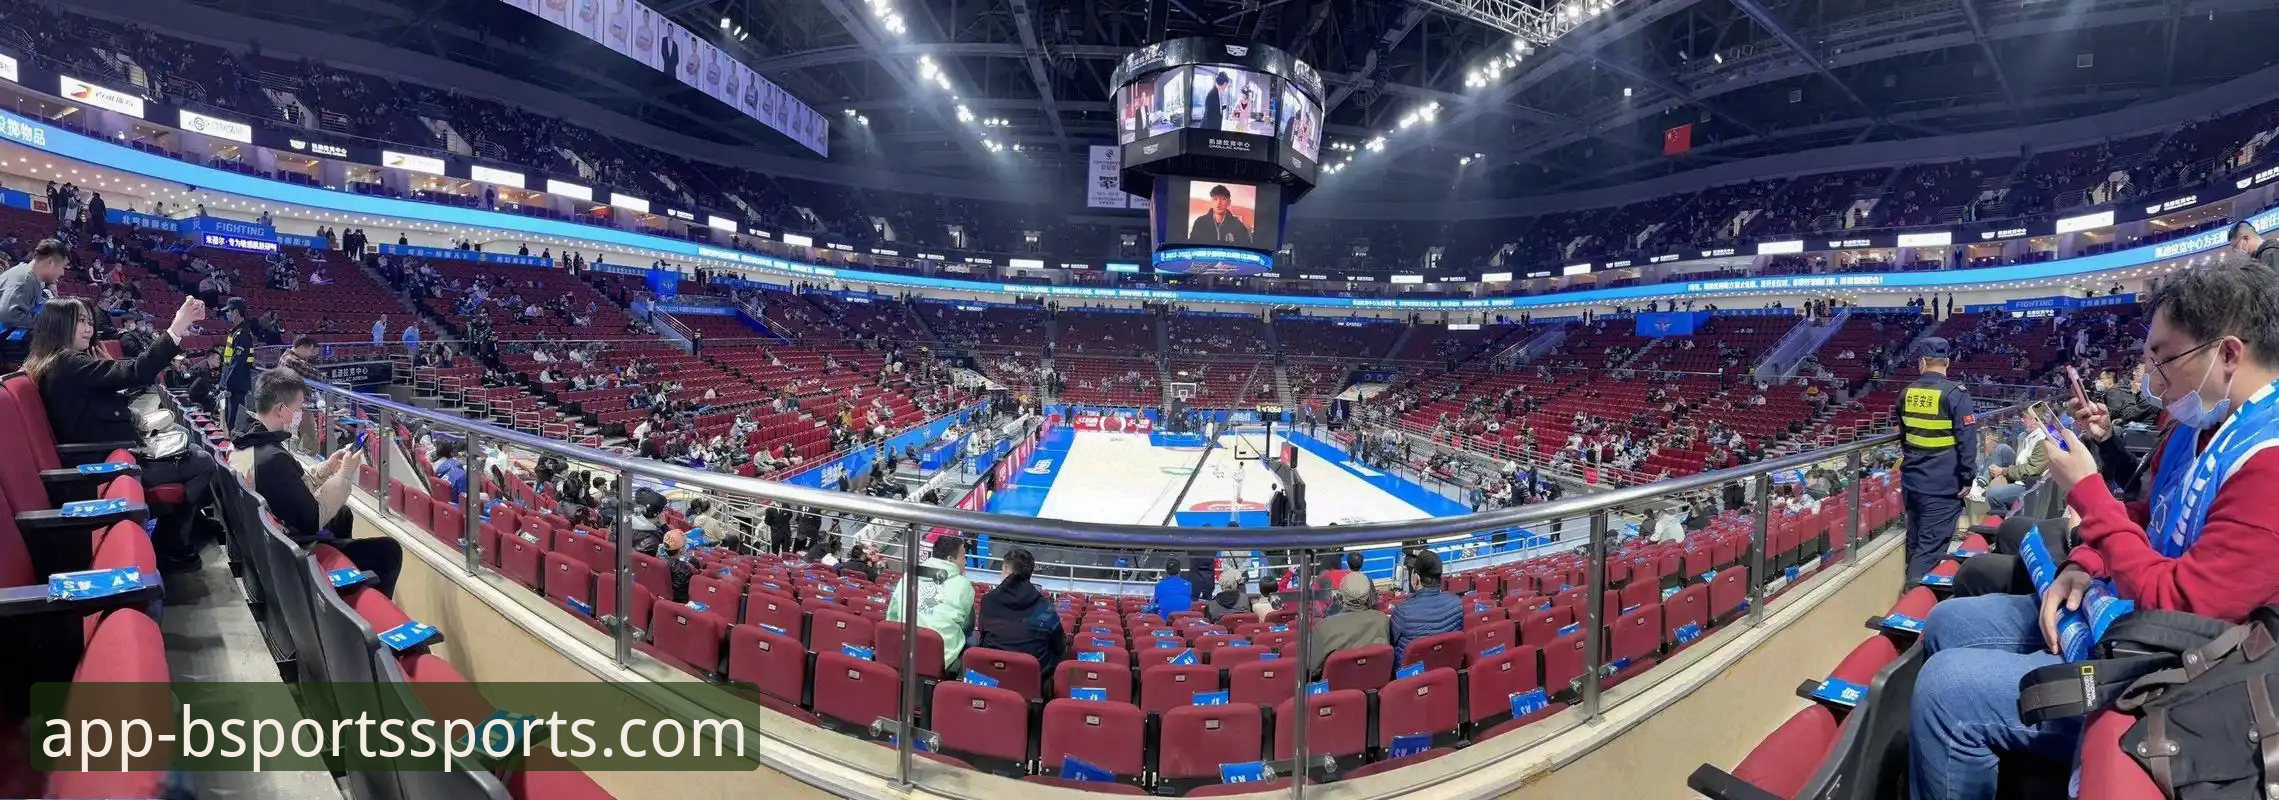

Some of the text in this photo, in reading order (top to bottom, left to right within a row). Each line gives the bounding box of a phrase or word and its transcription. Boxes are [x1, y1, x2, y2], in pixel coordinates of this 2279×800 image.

[216, 222, 264, 237] FIGHTING
[2016, 300, 2053, 308] FIGHTING
[1907, 394, 1933, 408] 中京安保
[2084, 675, 2093, 707] GEOGRAPHIC
